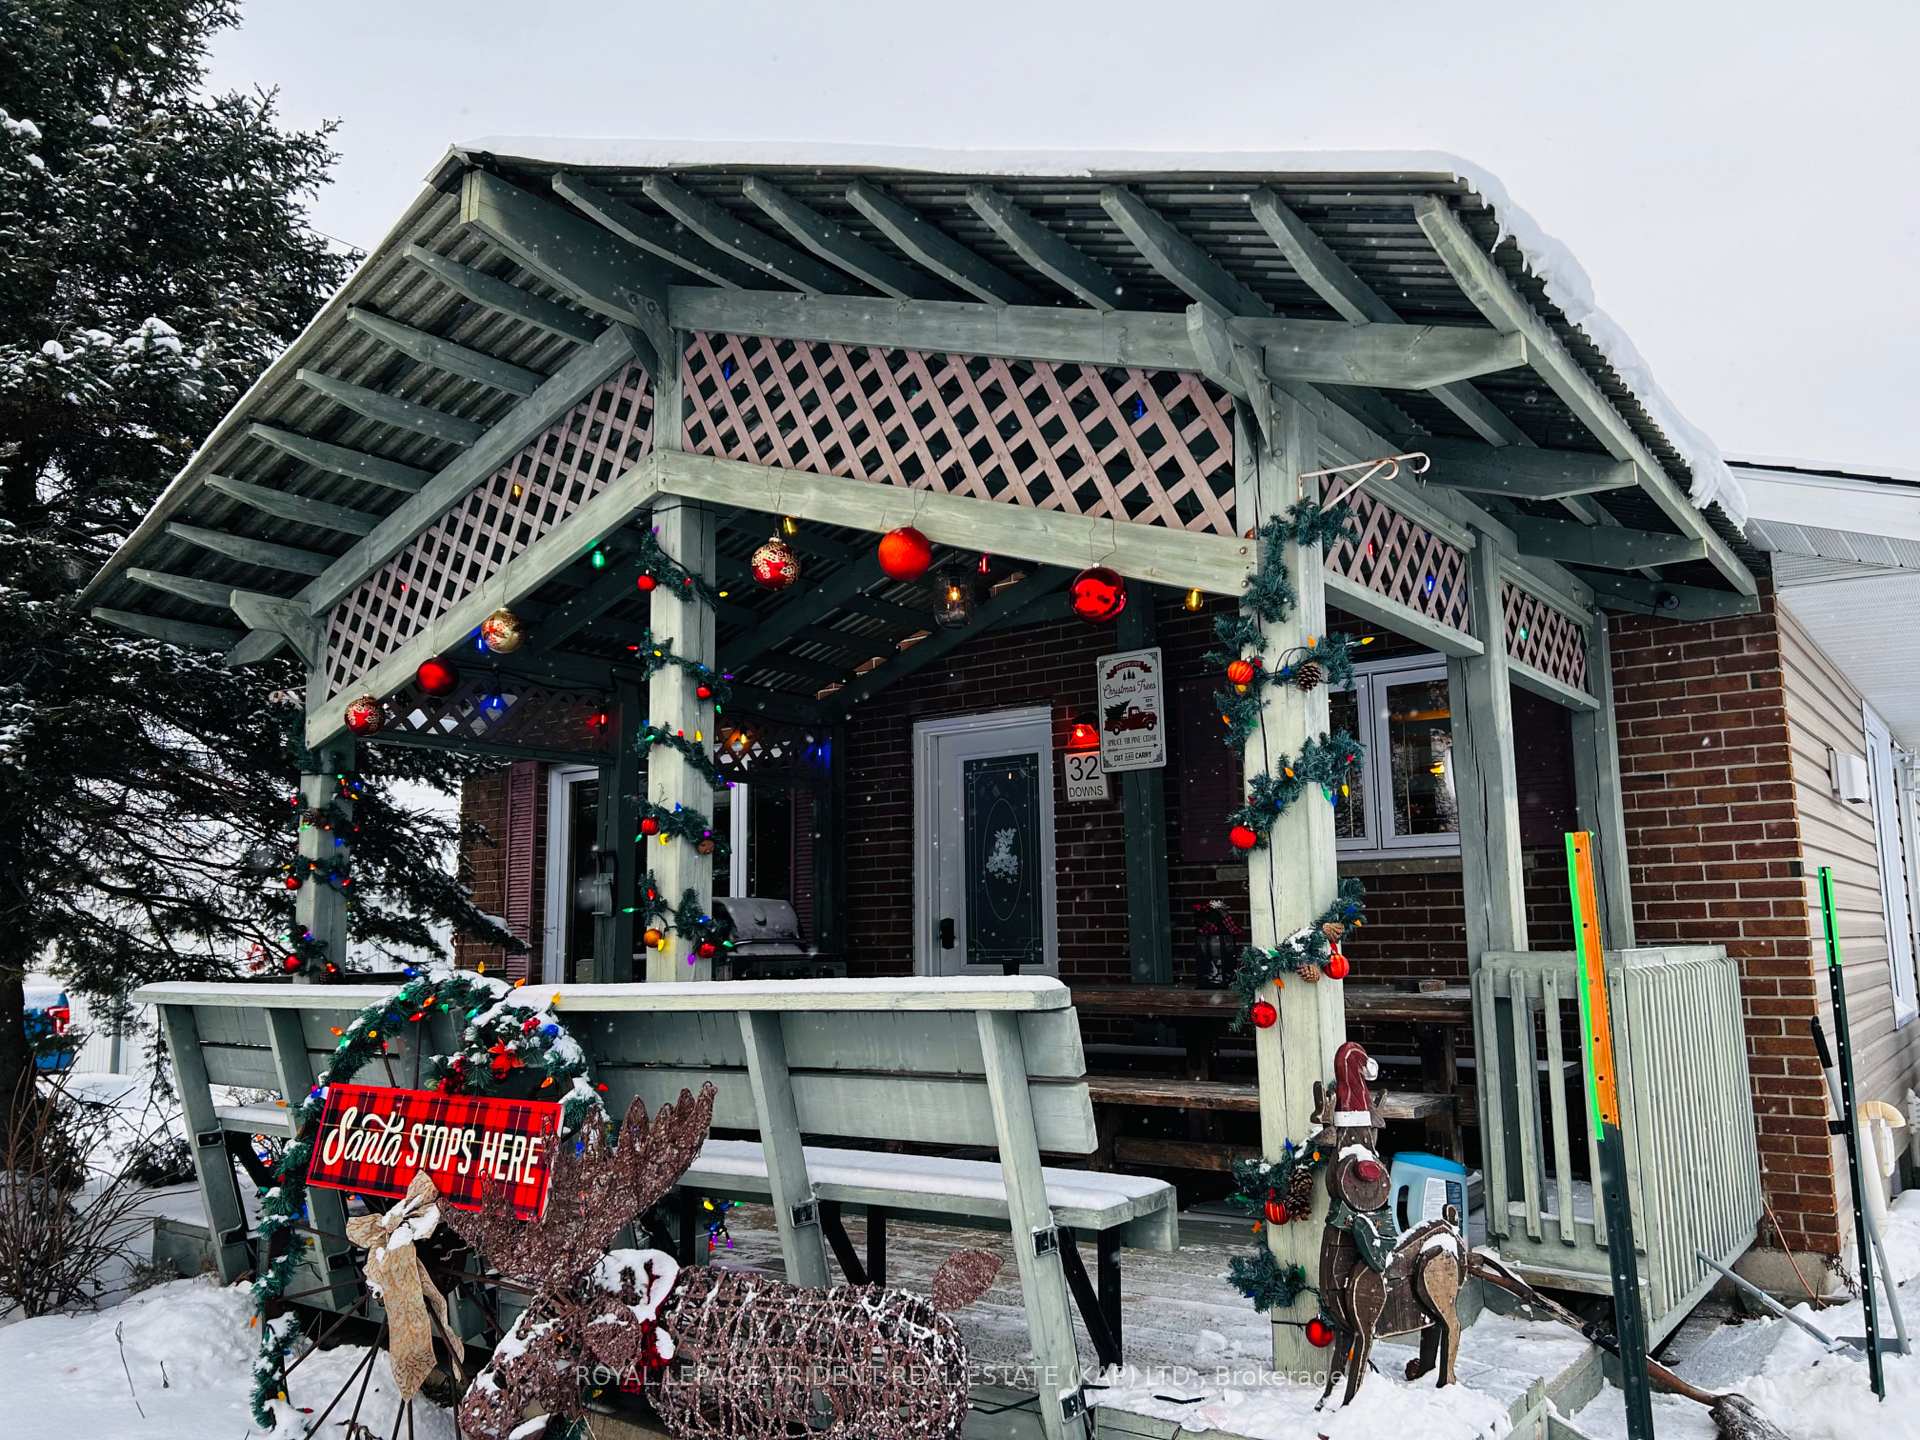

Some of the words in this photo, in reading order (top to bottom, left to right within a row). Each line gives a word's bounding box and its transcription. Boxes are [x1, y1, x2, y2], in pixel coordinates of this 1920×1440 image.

[1103, 682, 1136, 699] Christmas
[1137, 678, 1156, 693] Trees
[1070, 755, 1100, 781] 32
[1069, 785, 1104, 798] DOWNS
[322, 1106, 405, 1167] Santa
[405, 1123, 476, 1175] STOPS
[479, 1131, 542, 1185] HERE
